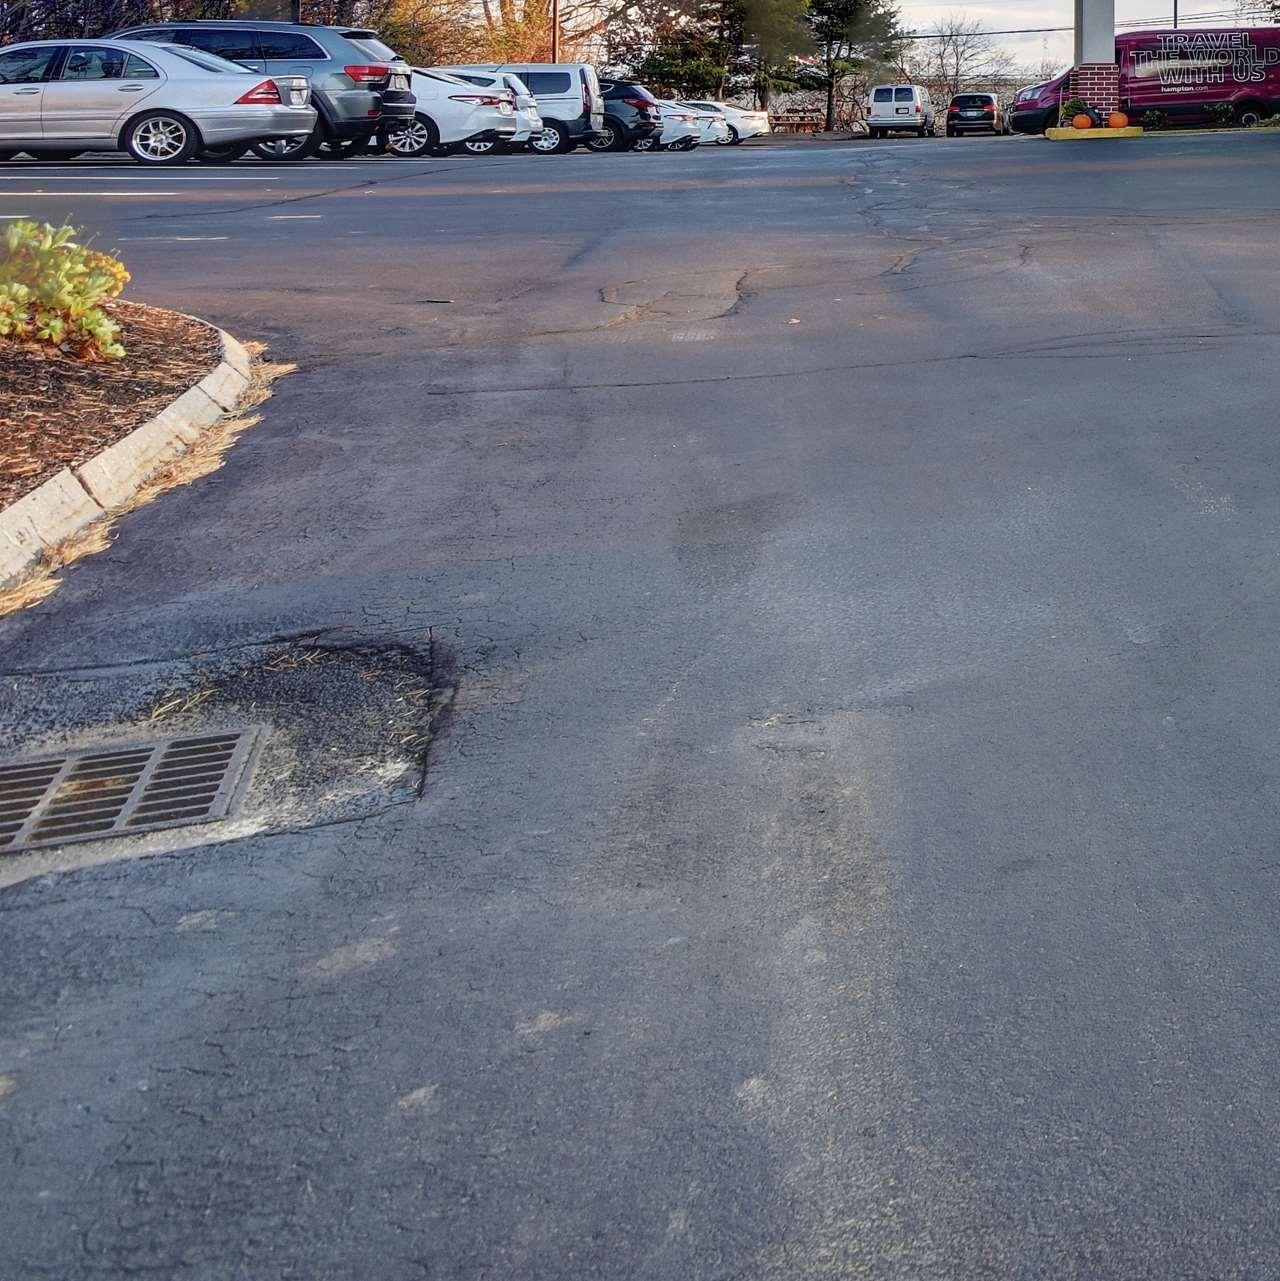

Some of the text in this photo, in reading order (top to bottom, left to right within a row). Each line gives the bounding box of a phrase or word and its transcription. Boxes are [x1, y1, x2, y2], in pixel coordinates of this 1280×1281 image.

[1157, 32, 1256, 52] TRAVEL
[1130, 50, 1181, 69] THE
[1158, 64, 1266, 84] WITH US
[1161, 85, 1209, 93] hampton.com
